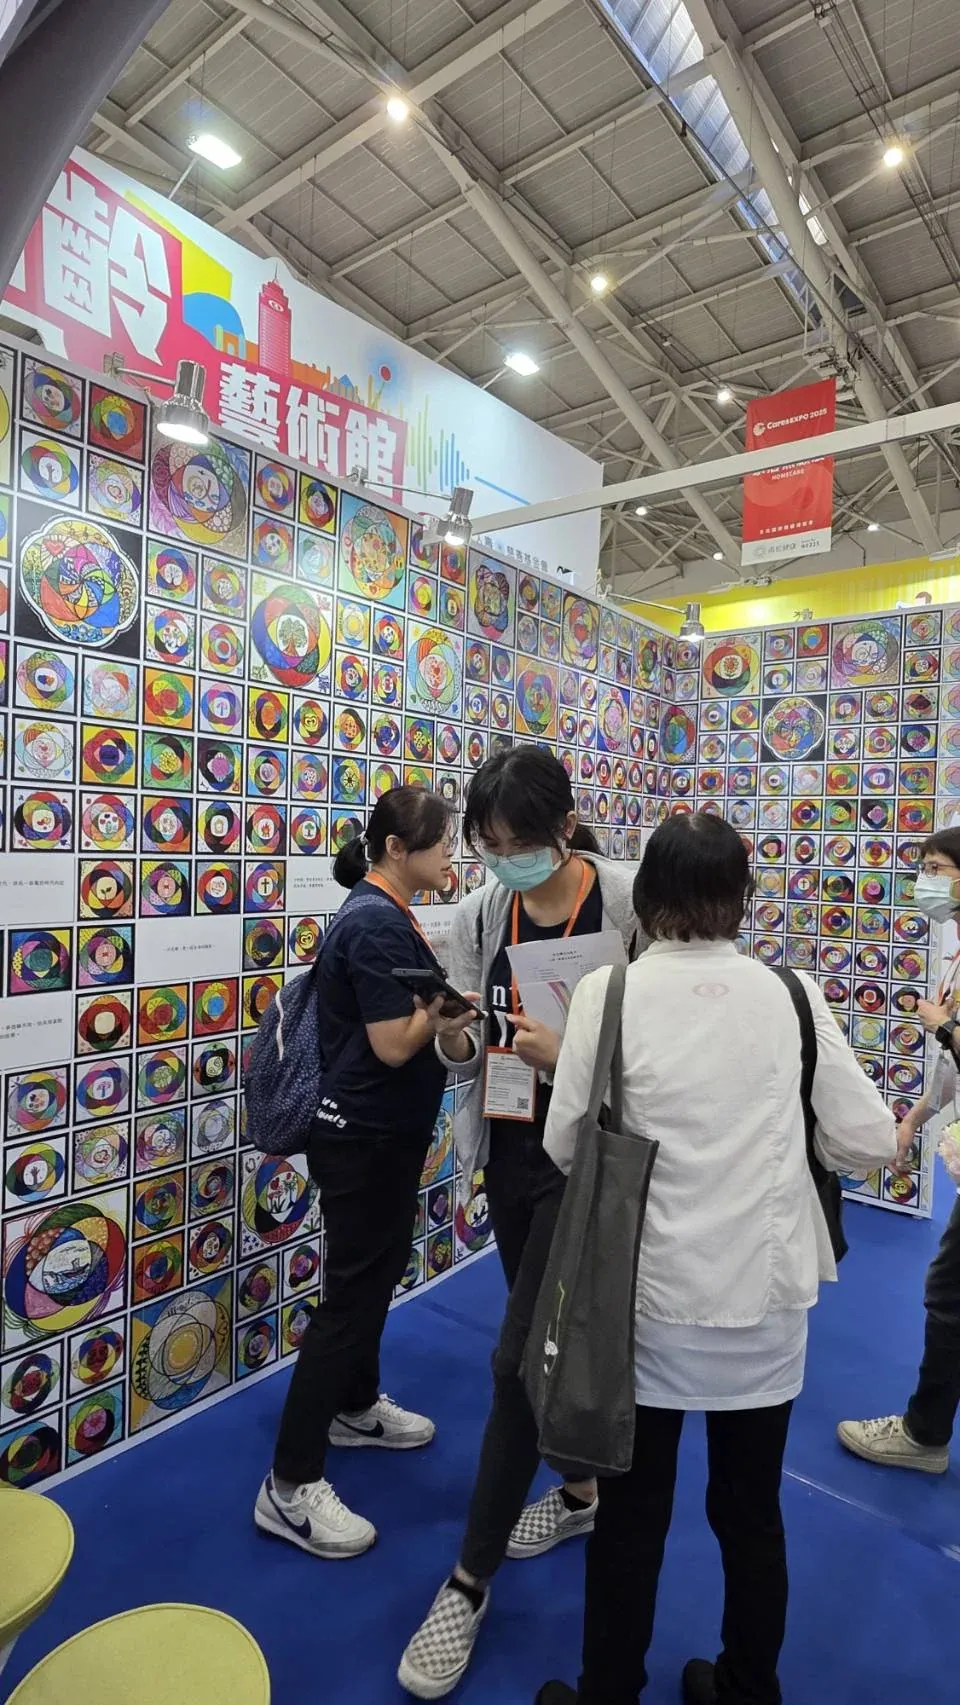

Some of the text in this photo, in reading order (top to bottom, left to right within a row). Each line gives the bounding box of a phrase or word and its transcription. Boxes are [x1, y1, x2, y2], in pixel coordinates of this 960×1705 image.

[218, 361, 397, 500] 藝術館
[809, 407, 828, 419] 2025
